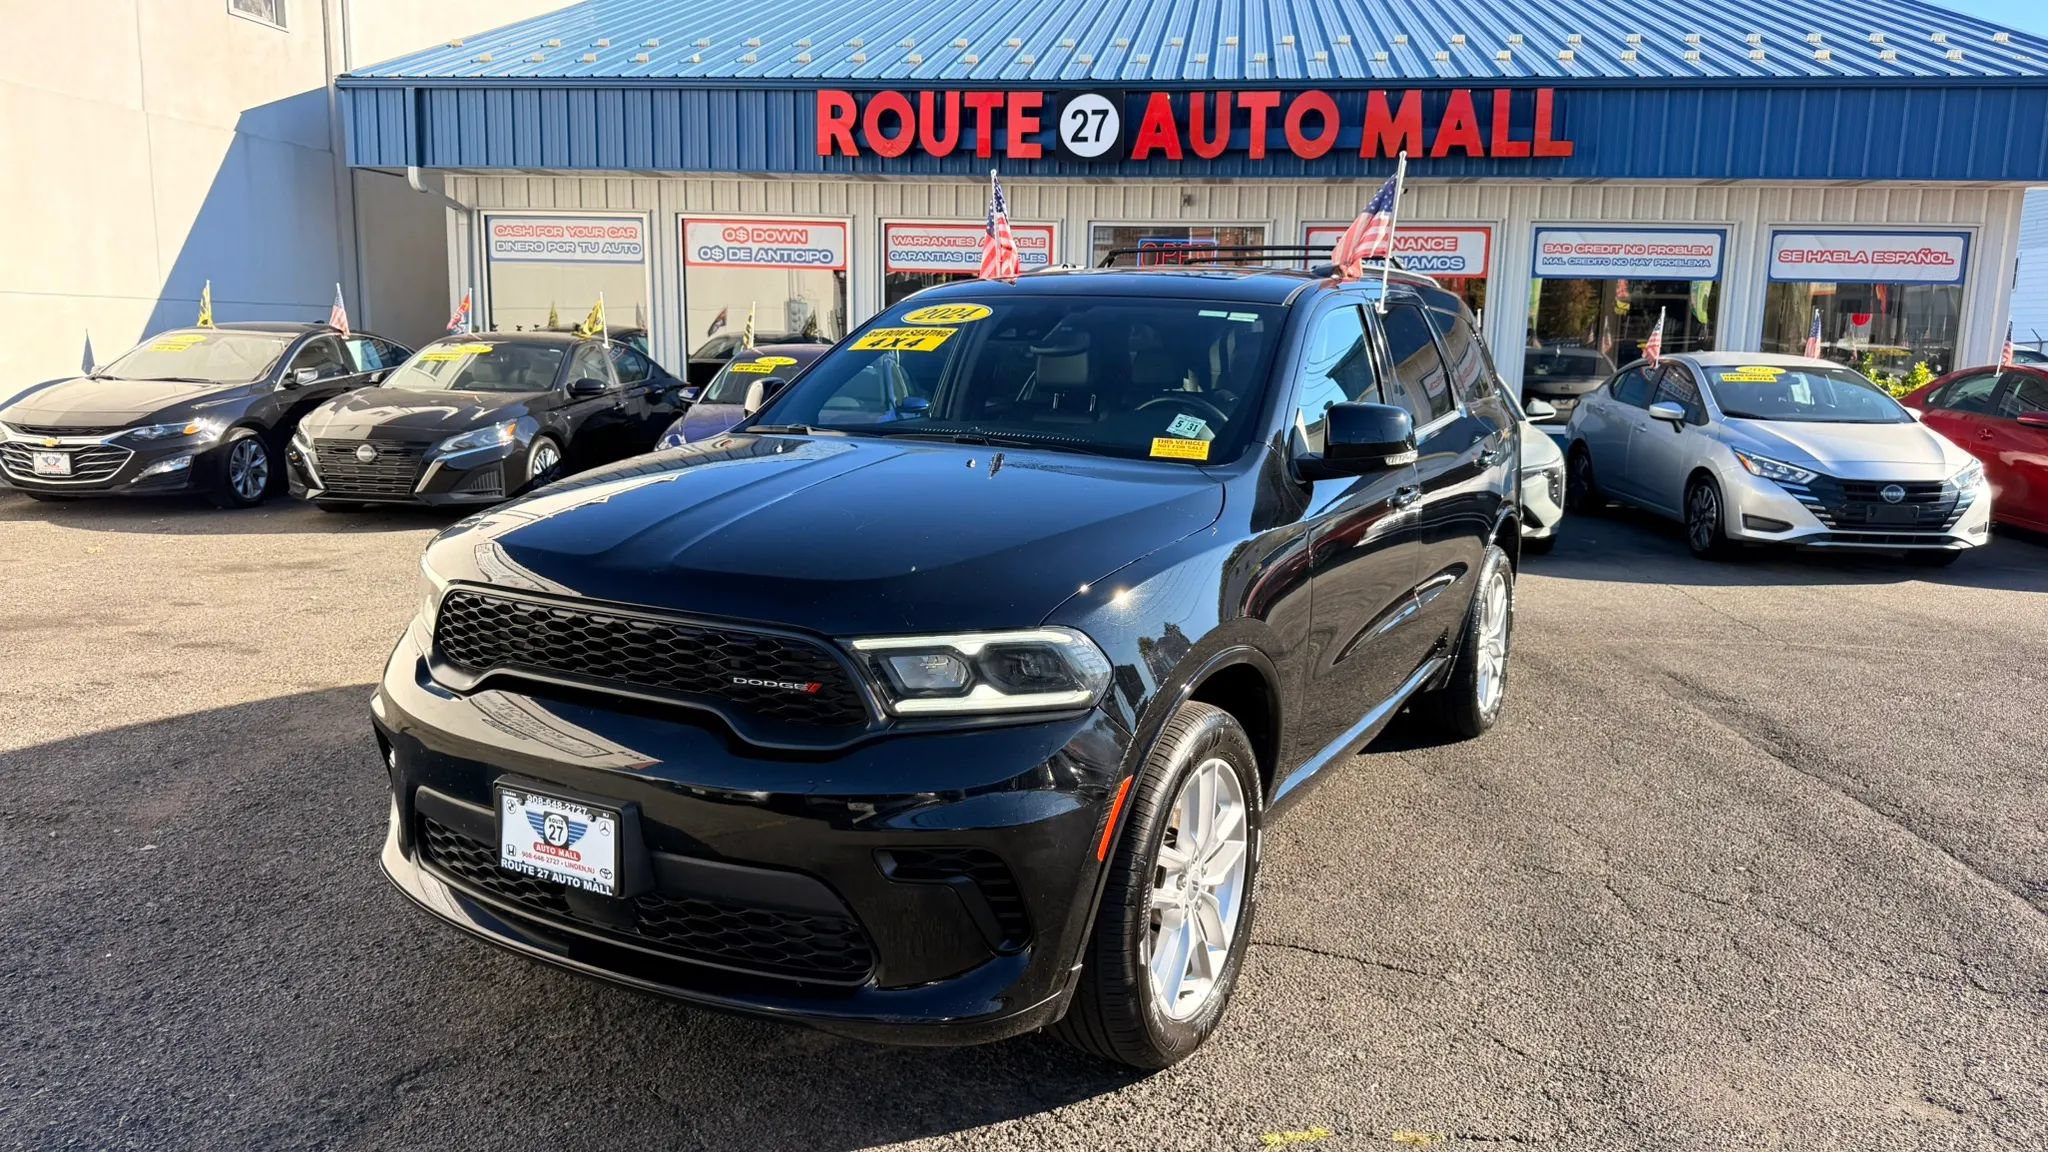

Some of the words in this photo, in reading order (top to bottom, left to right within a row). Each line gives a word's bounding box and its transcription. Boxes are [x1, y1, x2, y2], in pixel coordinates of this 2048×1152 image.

[816, 90, 1044, 158] ROUTE
[1070, 109, 1110, 143] 27
[1131, 90, 1340, 160] AUTO
[1360, 88, 1573, 158] MALL
[495, 225, 533, 237] CASH
[536, 226, 564, 237] FOR
[566, 226, 605, 238] YOUR
[607, 227, 637, 239] CAR
[752, 228, 808, 245] DOWN
[496, 240, 545, 252] DINERO
[546, 241, 576, 253] POR
[578, 242, 600, 253] TU
[602, 242, 641, 254] AUTO
[892, 235, 976, 248] WARRANTIES
[727, 247, 752, 262] DE
[754, 247, 834, 264] ANTICIPO
[889, 250, 963, 263] GARANTIAS
[1543, 243, 1573, 254] BAD
[1575, 243, 1624, 255] CREDIT
[1624, 244, 1646, 255] NO
[1647, 244, 1713, 256] PROBLEM
[1778, 249, 1805, 263] SE
[1806, 250, 1869, 264] HABLA
[1871, 248, 1954, 265] ESPAÑOL
[1542, 256, 1565, 266] MAL
[1567, 257, 1611, 267] CREDITO
[1612, 257, 1629, 267] NO
[1630, 257, 1652, 267] HAY
[1653, 258, 1711, 268] PROBLEMA
[912, 307, 982, 320] 2024
[907, 329, 953, 338] SEATING
[1175, 420, 1184, 428] 5
[1186, 423, 1198, 432] 31
[733, 677, 808, 691] DODGE
[502, 789, 517, 797] Linden
[526, 794, 588, 816] 908-648-2727
[548, 817, 564, 826] ROUTE
[548, 824, 563, 842] 27
[521, 851, 560, 865] 908-648-2727
[536, 843, 557, 855] AUTO
[558, 847, 579, 860] MALL
[501, 858, 535, 876] ROUTE
[536, 869, 549, 879] 27
[551, 873, 581, 888] AUTO
[583, 881, 613, 896] MALL
